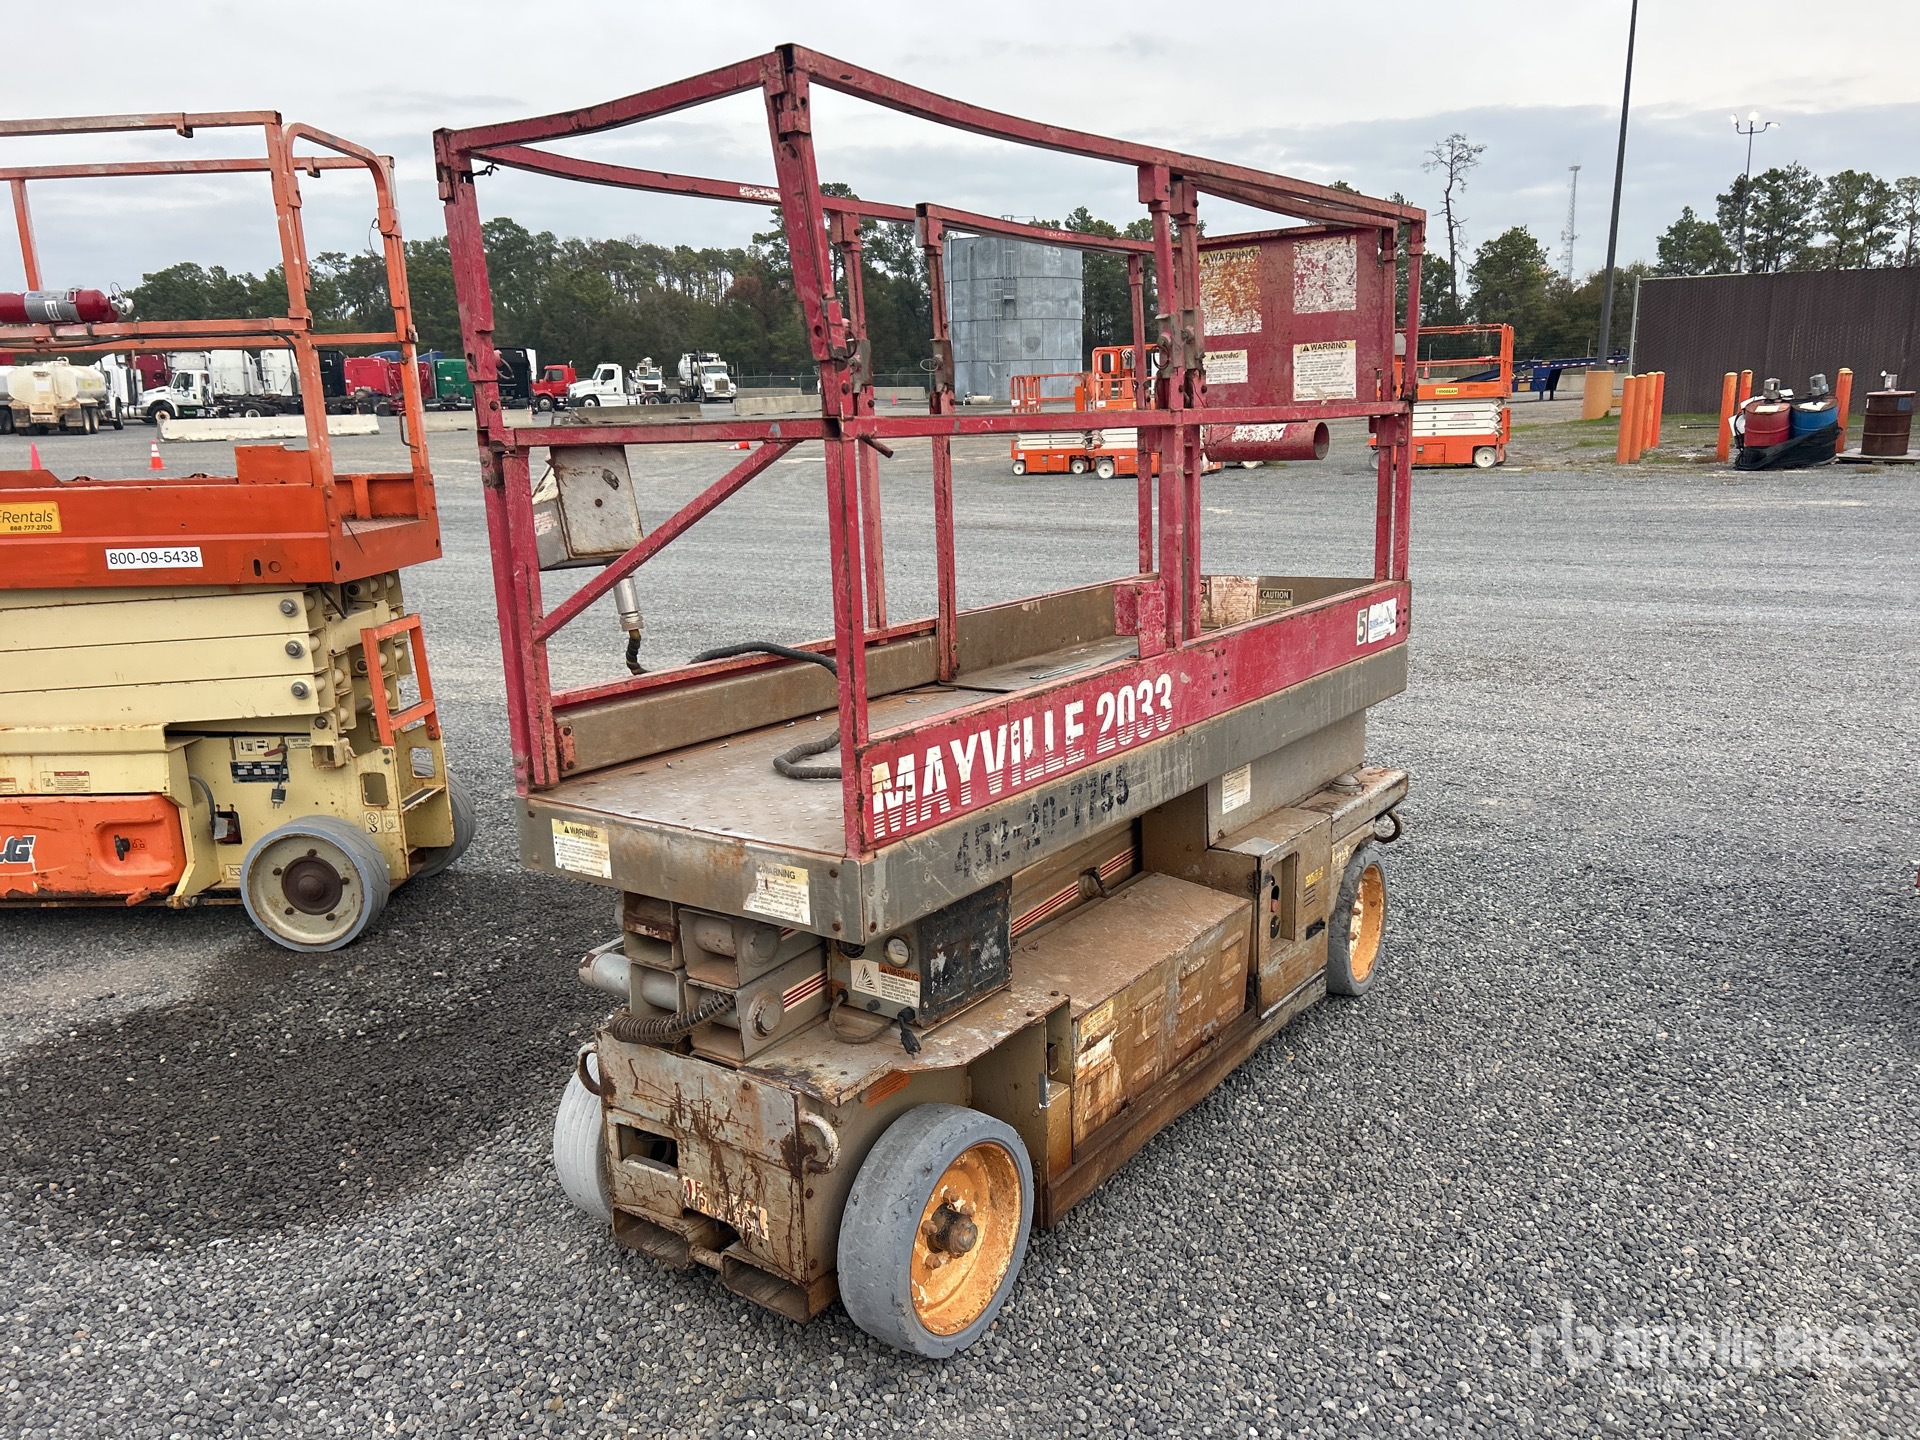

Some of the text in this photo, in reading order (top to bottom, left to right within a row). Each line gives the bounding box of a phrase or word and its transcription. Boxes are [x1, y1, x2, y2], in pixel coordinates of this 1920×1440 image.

[1311, 341, 1348, 351] WARNING
[1215, 351, 1240, 360] WARNING
[109, 550, 199, 565] 800-09-5438
[1261, 590, 1290, 600] CAUTION
[1357, 611, 1367, 644] 5
[871, 673, 1174, 839] MAYVILLE 2033
[569, 825, 599, 839] WARNING
[886, 967, 919, 982] WARNING
